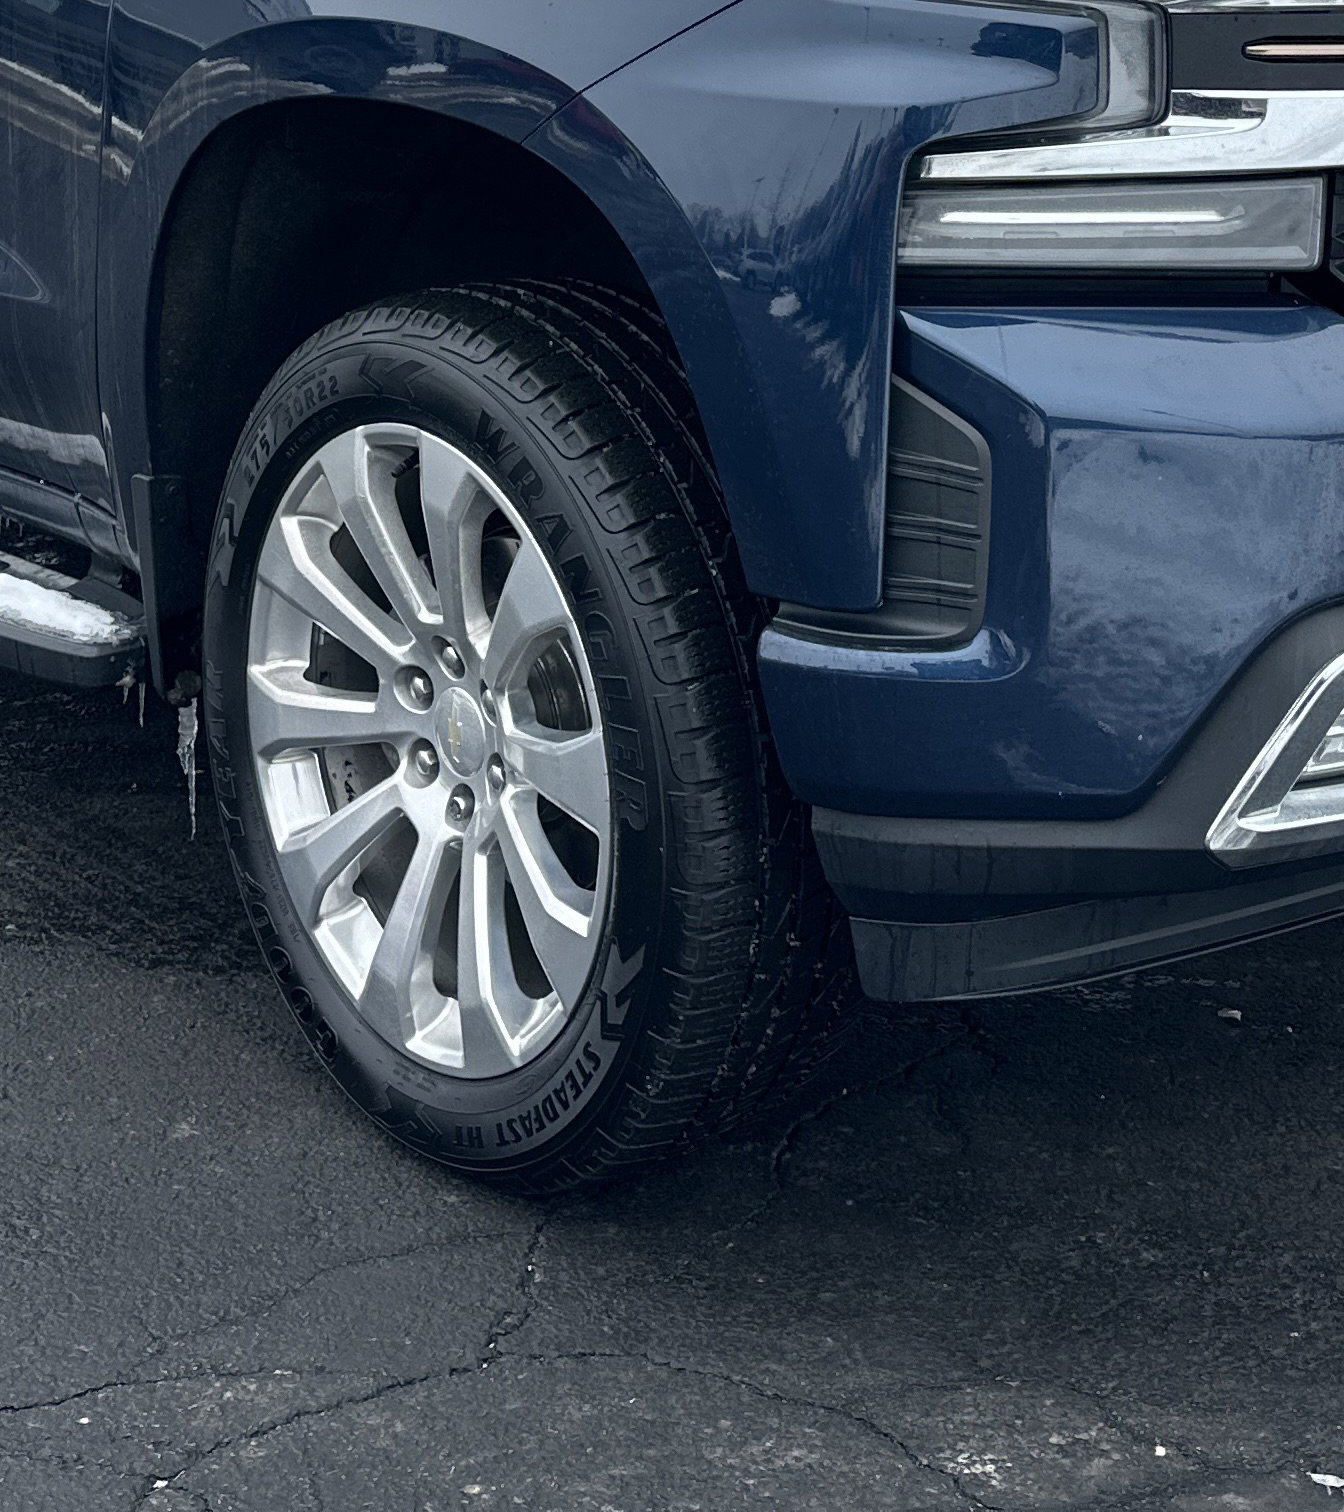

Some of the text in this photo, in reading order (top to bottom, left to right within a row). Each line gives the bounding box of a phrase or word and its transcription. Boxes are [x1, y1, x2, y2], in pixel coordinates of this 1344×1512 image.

[475, 406, 650, 834] WRANGLER
[450, 1040, 602, 1149] STEADFAST HT
